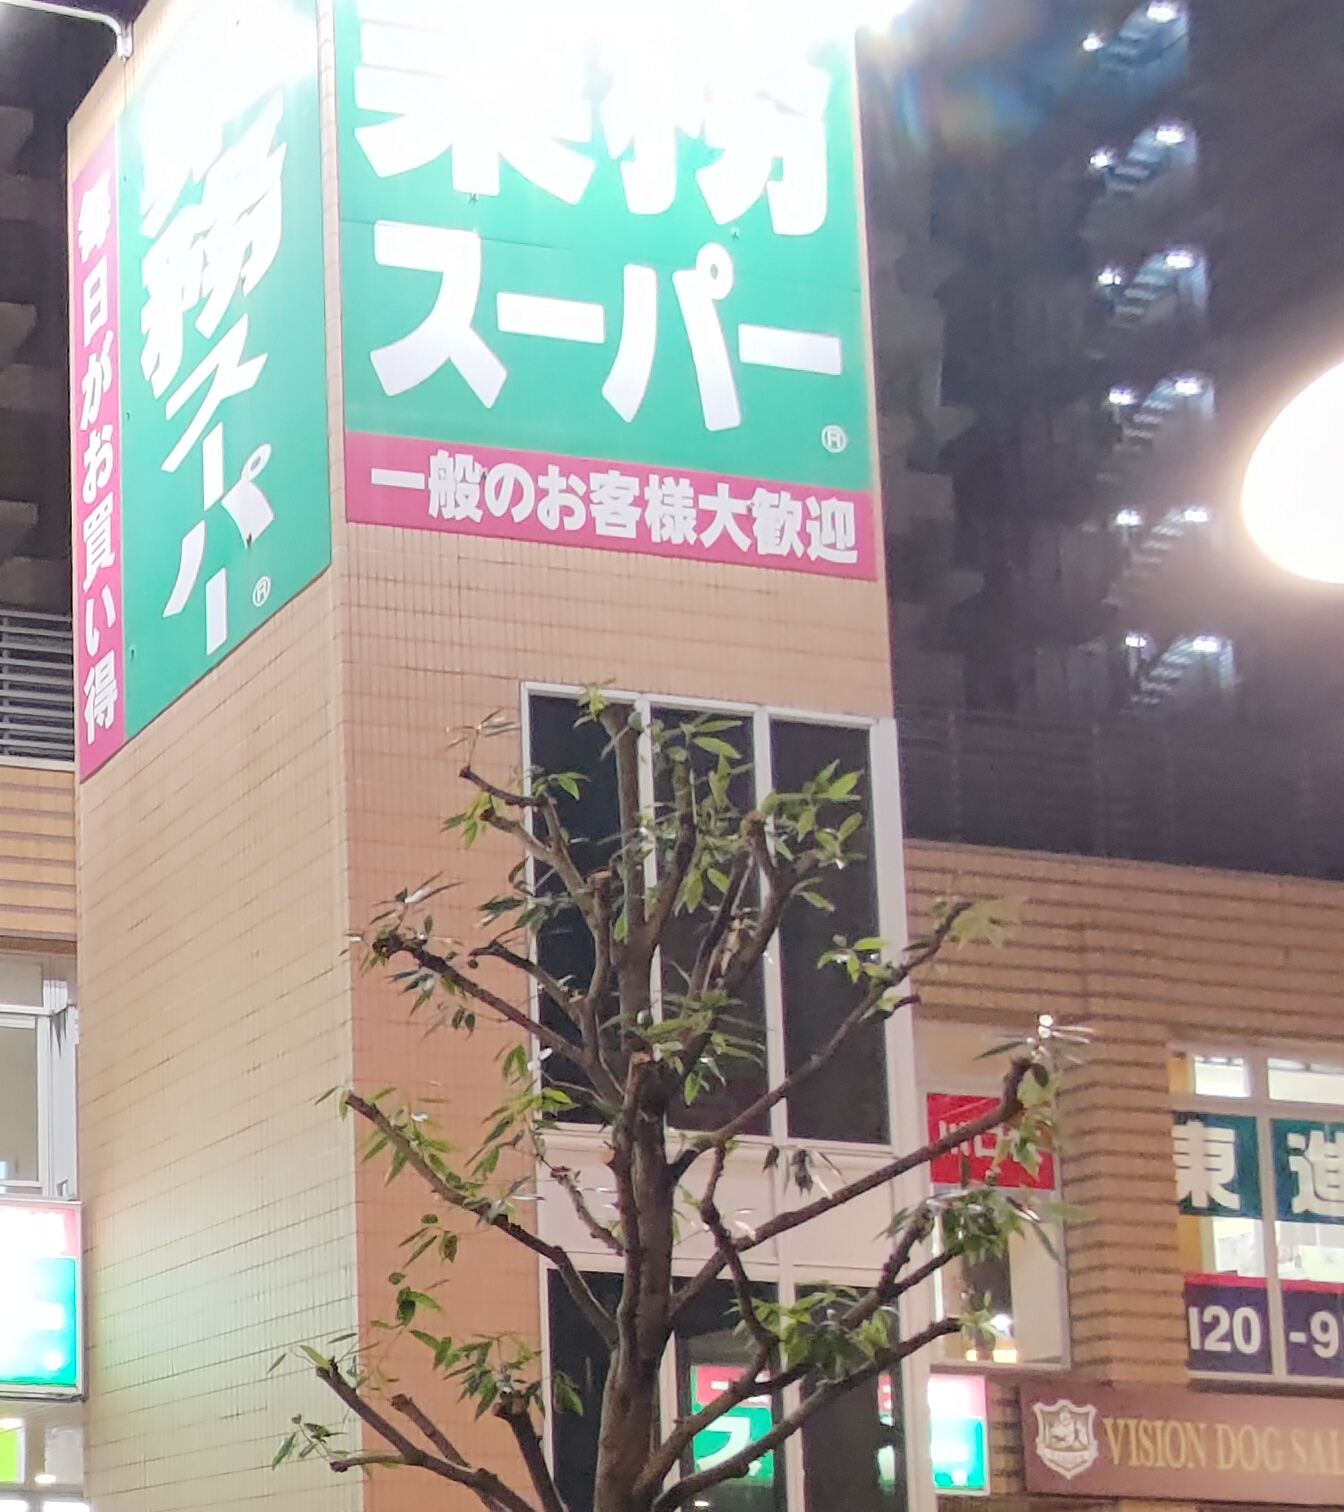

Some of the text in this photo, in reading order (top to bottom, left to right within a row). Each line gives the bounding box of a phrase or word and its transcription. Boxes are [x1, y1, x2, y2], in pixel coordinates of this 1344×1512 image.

[370, 220, 843, 432] スーパー
[75, 172, 120, 745] 毎日がお買い得
[370, 450, 859, 564] 一般のお客様大歓迎
[1101, 1417, 1207, 1469] VISION
[1215, 1423, 1283, 1472] DOG
